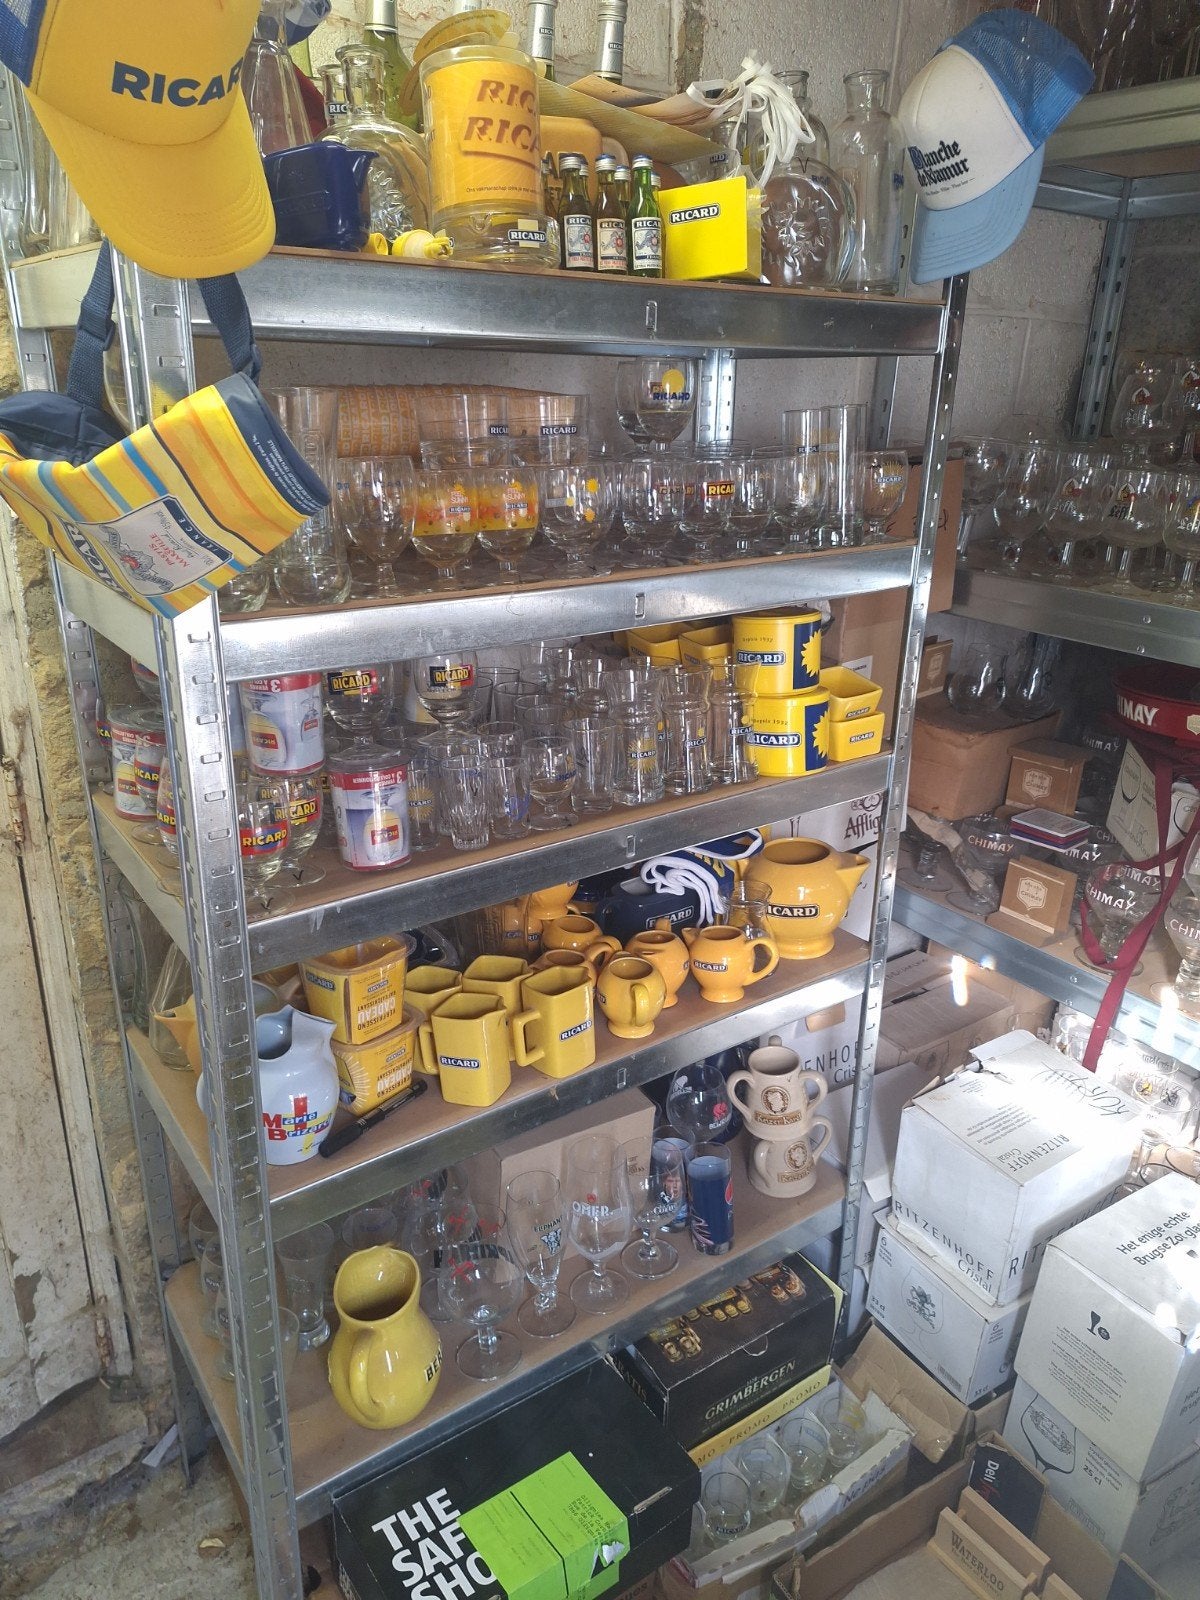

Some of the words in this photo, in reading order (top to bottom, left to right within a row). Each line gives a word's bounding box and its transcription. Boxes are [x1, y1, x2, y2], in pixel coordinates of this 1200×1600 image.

[672, 205, 718, 223] RICARD
[511, 231, 545, 241] RICARD
[542, 425, 577, 435] RICARD
[738, 652, 784, 663] RICARD
[333, 676, 371, 690] RICARD
[436, 669, 469, 683] RICARD
[269, 679, 281, 692] 3
[748, 734, 800, 745] RICARD
[851, 732, 874, 743] RICARD
[396, 771, 403, 784] 3
[243, 829, 287, 847] RICARD
[968, 835, 1014, 852] CHIMAY
[1086, 882, 1136, 910] CHIMAY
[695, 961, 727, 972] RICARD
[357, 998, 397, 1024] CADEAU
[561, 1021, 592, 1040] RICARD
[441, 1057, 479, 1069] RICARD
[263, 1111, 318, 1129] Marie
[997, 1149, 1022, 1163] Cristal
[1008, 1134, 1070, 1172] RITZENHOFF
[894, 1200, 994, 1281] RITZENHOFF
[1116, 1240, 1140, 1255] Het
[1137, 1226, 1165, 1244] enige
[1163, 1212, 1191, 1229] echte
[1133, 1242, 1171, 1266] Brugse
[1165, 1232, 1187, 1246] Zot
[957, 1259, 993, 1293] Cristal
[704, 1360, 796, 1421] GRIMBERGEN
[728, 1413, 770, 1445] PROMO
[782, 1379, 822, 1411] PROMO
[984, 1460, 999, 1483] Deli
[1082, 1463, 1096, 1478] 25
[371, 1488, 460, 1551] THE
[951, 1530, 1004, 1592] WATERLOO
